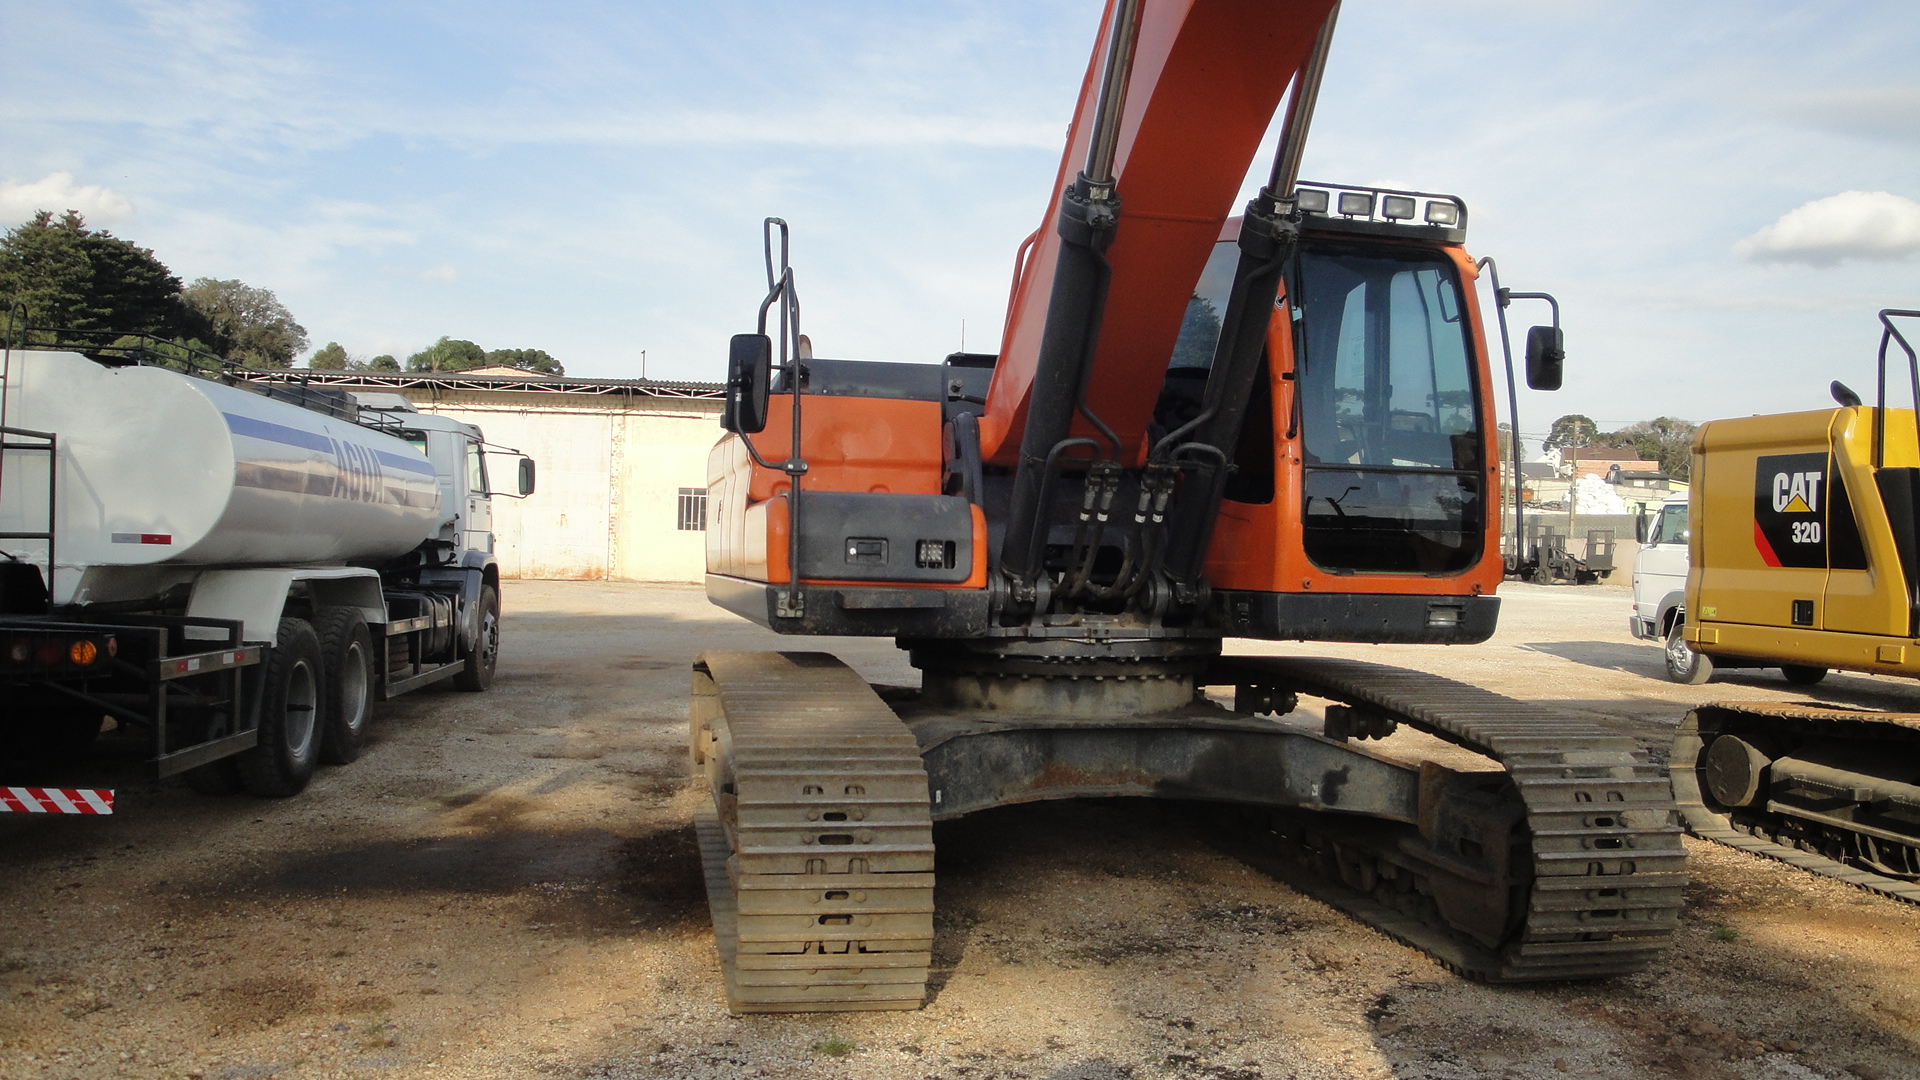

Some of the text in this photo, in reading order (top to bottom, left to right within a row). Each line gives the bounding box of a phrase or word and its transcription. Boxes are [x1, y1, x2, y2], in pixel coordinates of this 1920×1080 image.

[324, 425, 383, 504] ÁGUA
[1772, 471, 1822, 513] CAT
[1791, 521, 1821, 544] 320
